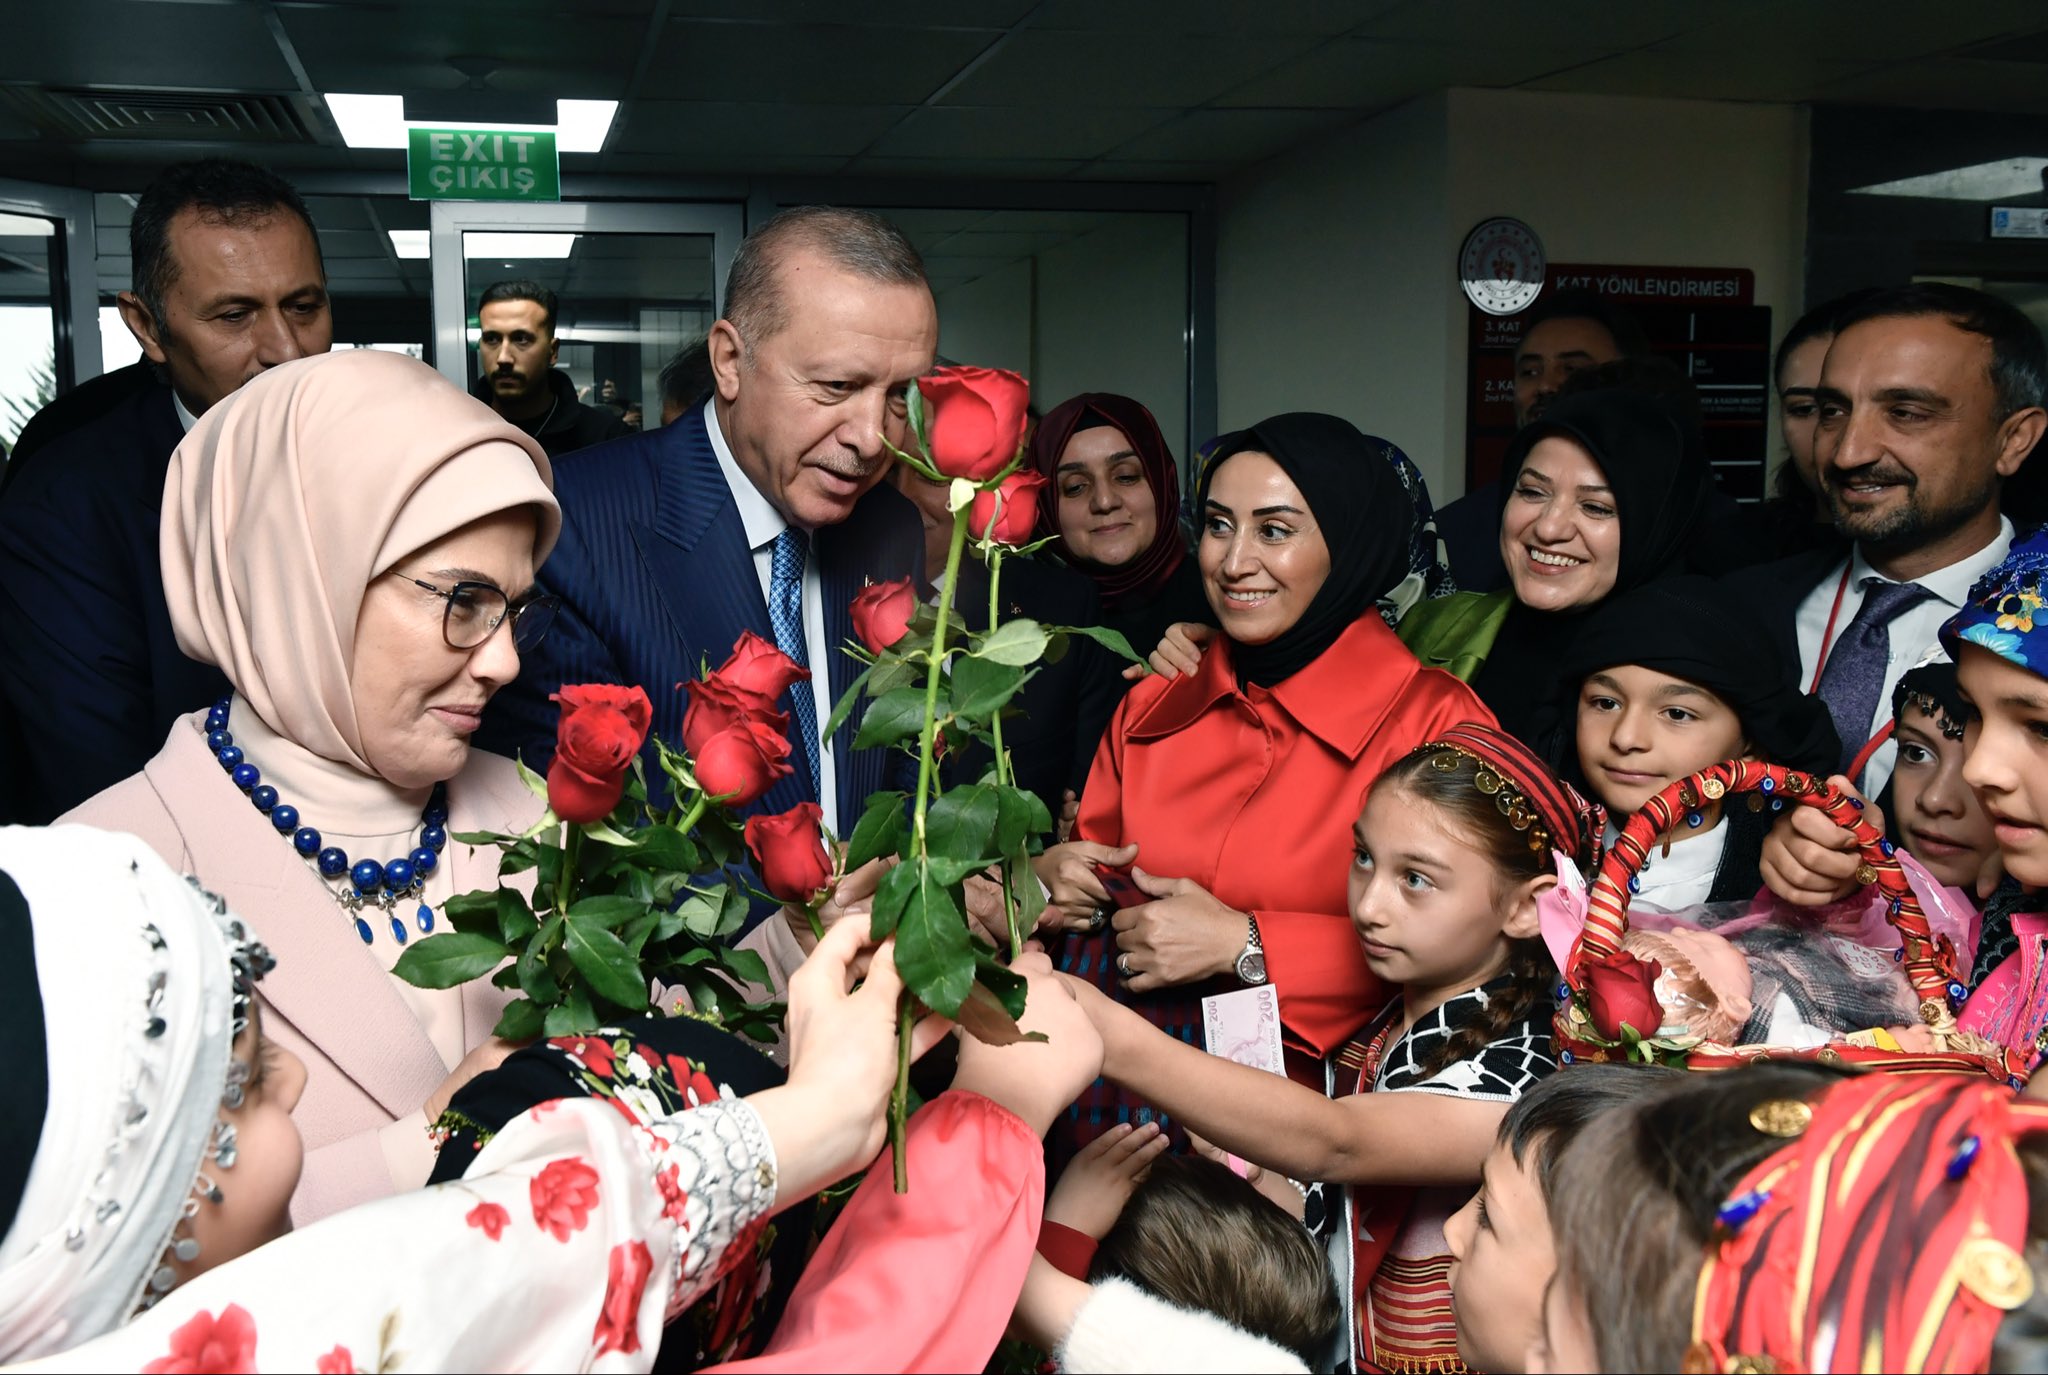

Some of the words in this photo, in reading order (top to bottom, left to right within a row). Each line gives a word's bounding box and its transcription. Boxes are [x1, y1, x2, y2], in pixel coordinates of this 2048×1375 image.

[429, 133, 536, 164] EXIT
[428, 165, 536, 196] ÇIKIŞ
[1555, 274, 1593, 290] KAT
[1595, 273, 1740, 296] YÖNLENDİRMESİ
[1484, 320, 1496, 332] 3.
[1498, 320, 1521, 332] KAT
[1485, 380, 1496, 391] 2.
[1498, 380, 1514, 391] KA
[1207, 1000, 1218, 1022] 200
[1258, 990, 1274, 1022] 200
